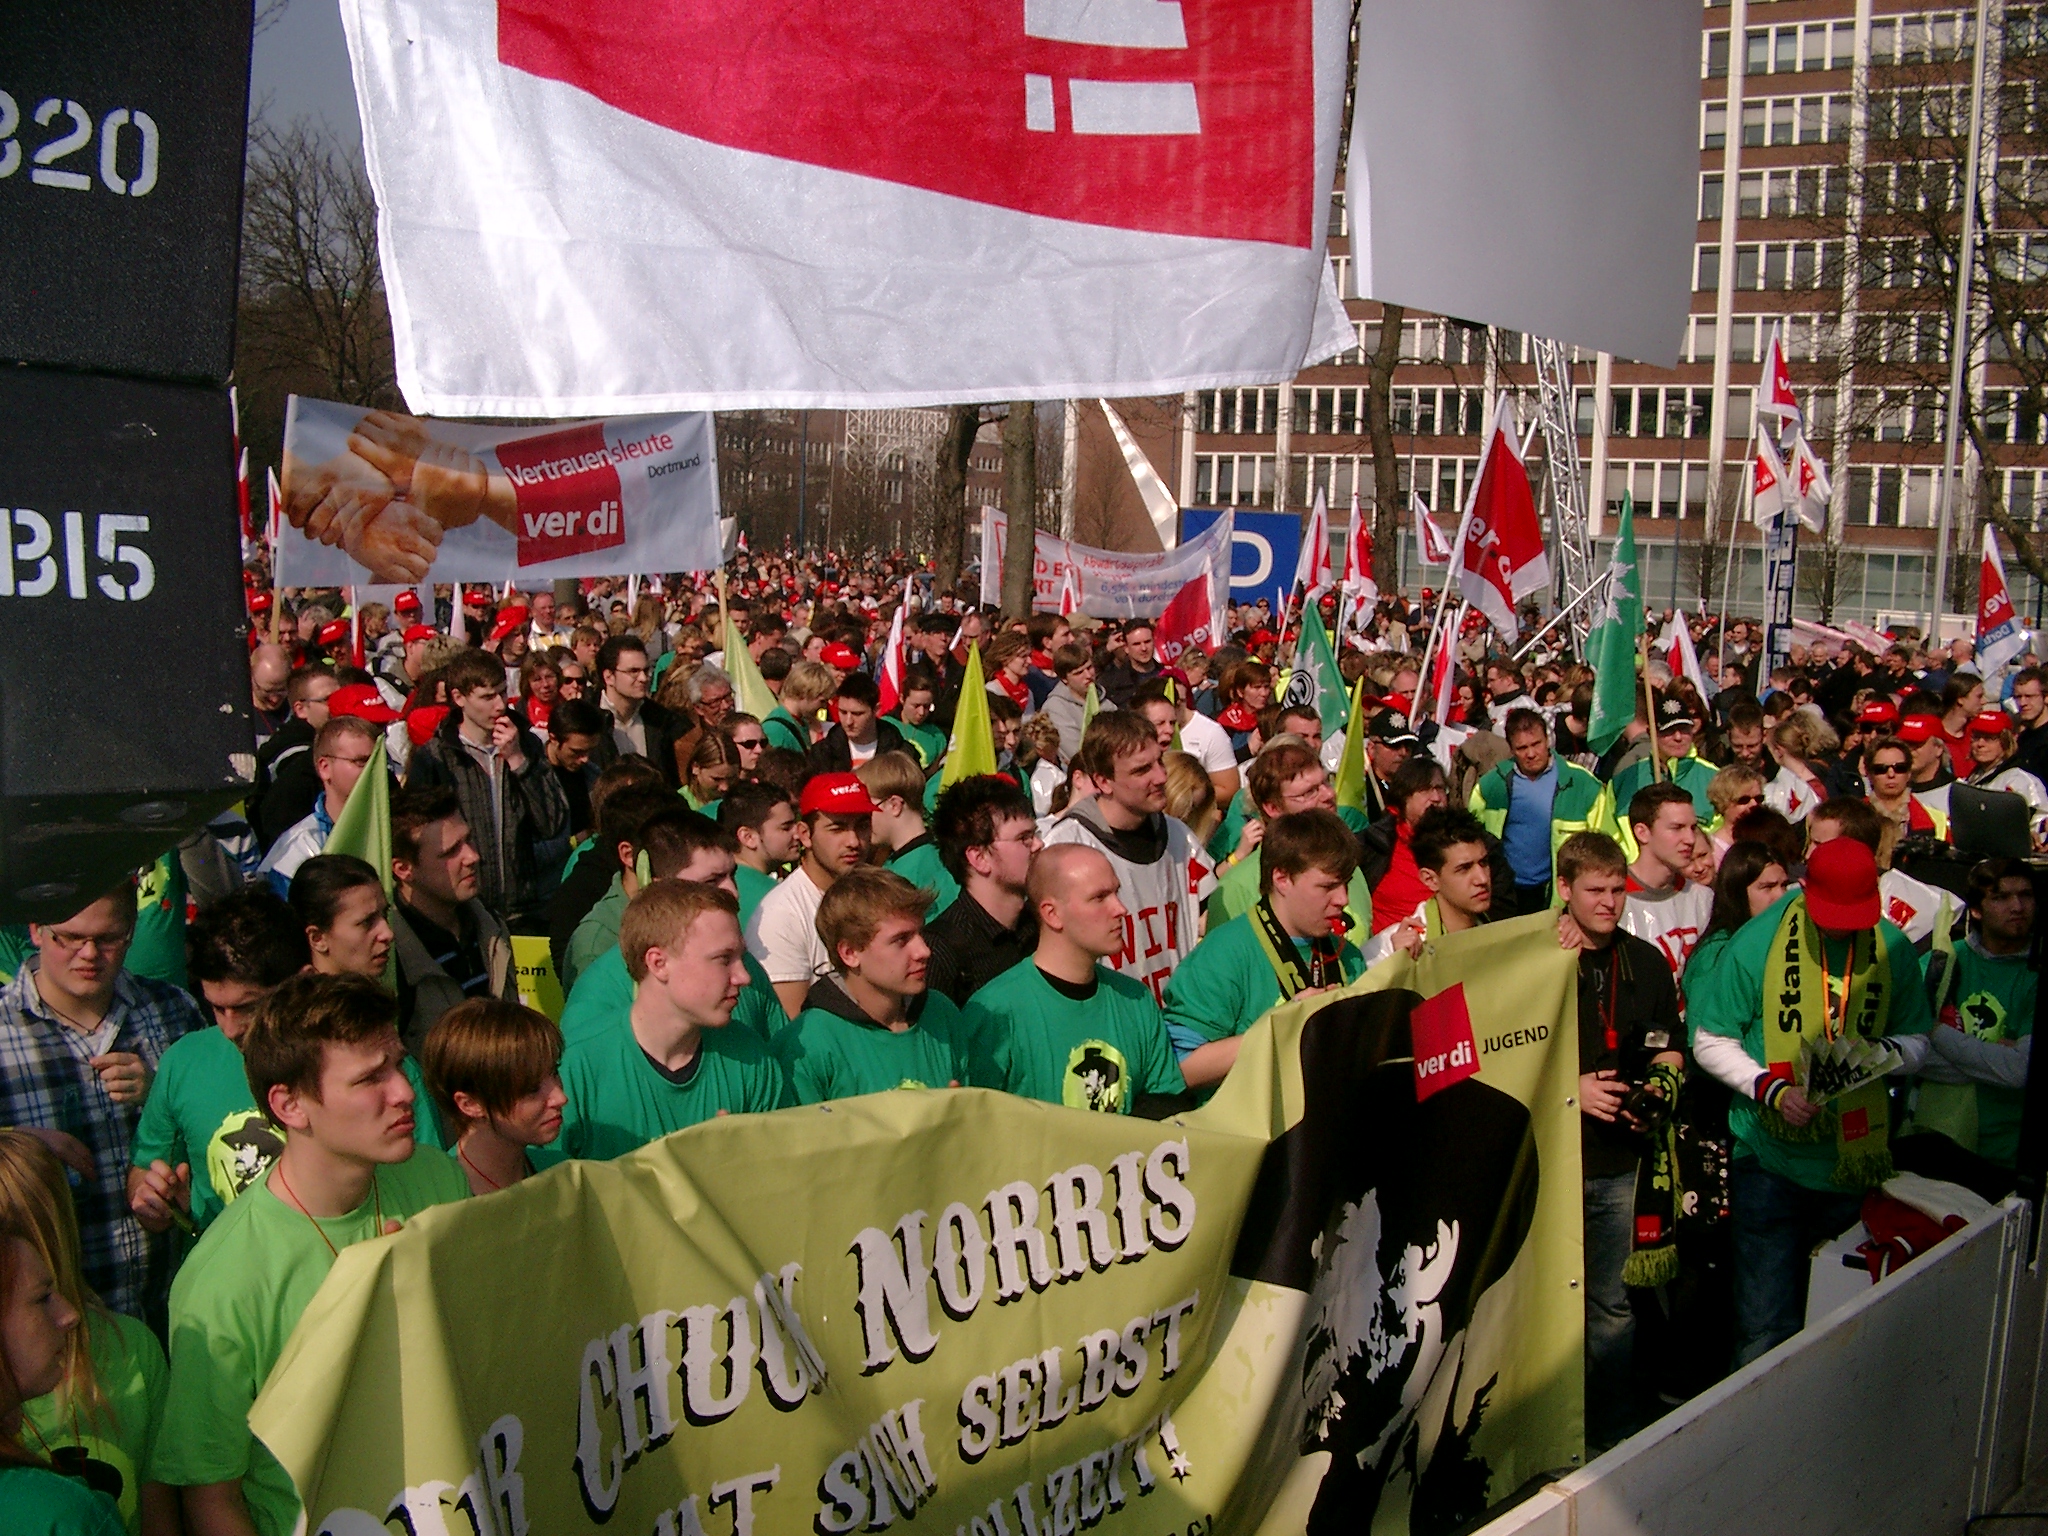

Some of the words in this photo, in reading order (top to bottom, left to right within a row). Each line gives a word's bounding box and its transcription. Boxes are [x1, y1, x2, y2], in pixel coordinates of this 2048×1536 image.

[505, 433, 674, 487] Vertrauensleute
[647, 454, 701, 479] Dortmund
[1483, 1025, 1549, 1055] JUGEND
[846, 1136, 1197, 1376] NORRIS
[957, 1289, 1200, 1463] SELBST
